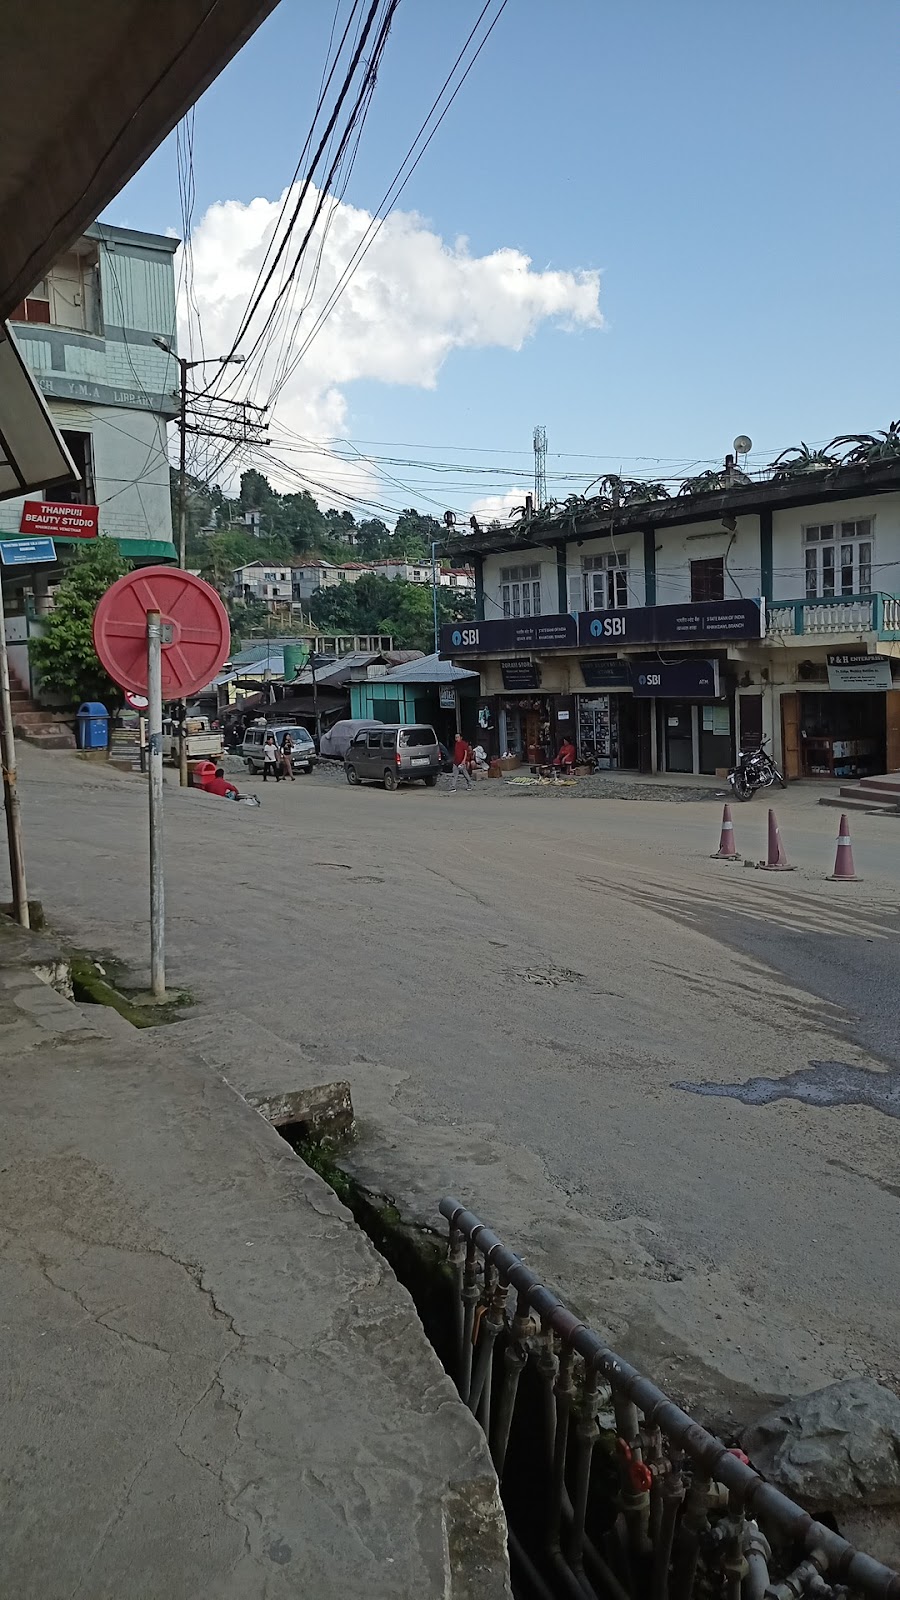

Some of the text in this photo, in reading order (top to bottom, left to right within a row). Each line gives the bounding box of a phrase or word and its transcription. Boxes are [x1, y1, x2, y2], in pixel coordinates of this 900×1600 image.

[25, 513, 94, 527] BEAUTY STUDIO
[603, 616, 626, 636] SBI
[462, 628, 480, 646] SBI
[830, 656, 835, 664] P
[835, 655, 842, 664] &
[842, 655, 849, 664] H
[646, 674, 661, 685] SBI
